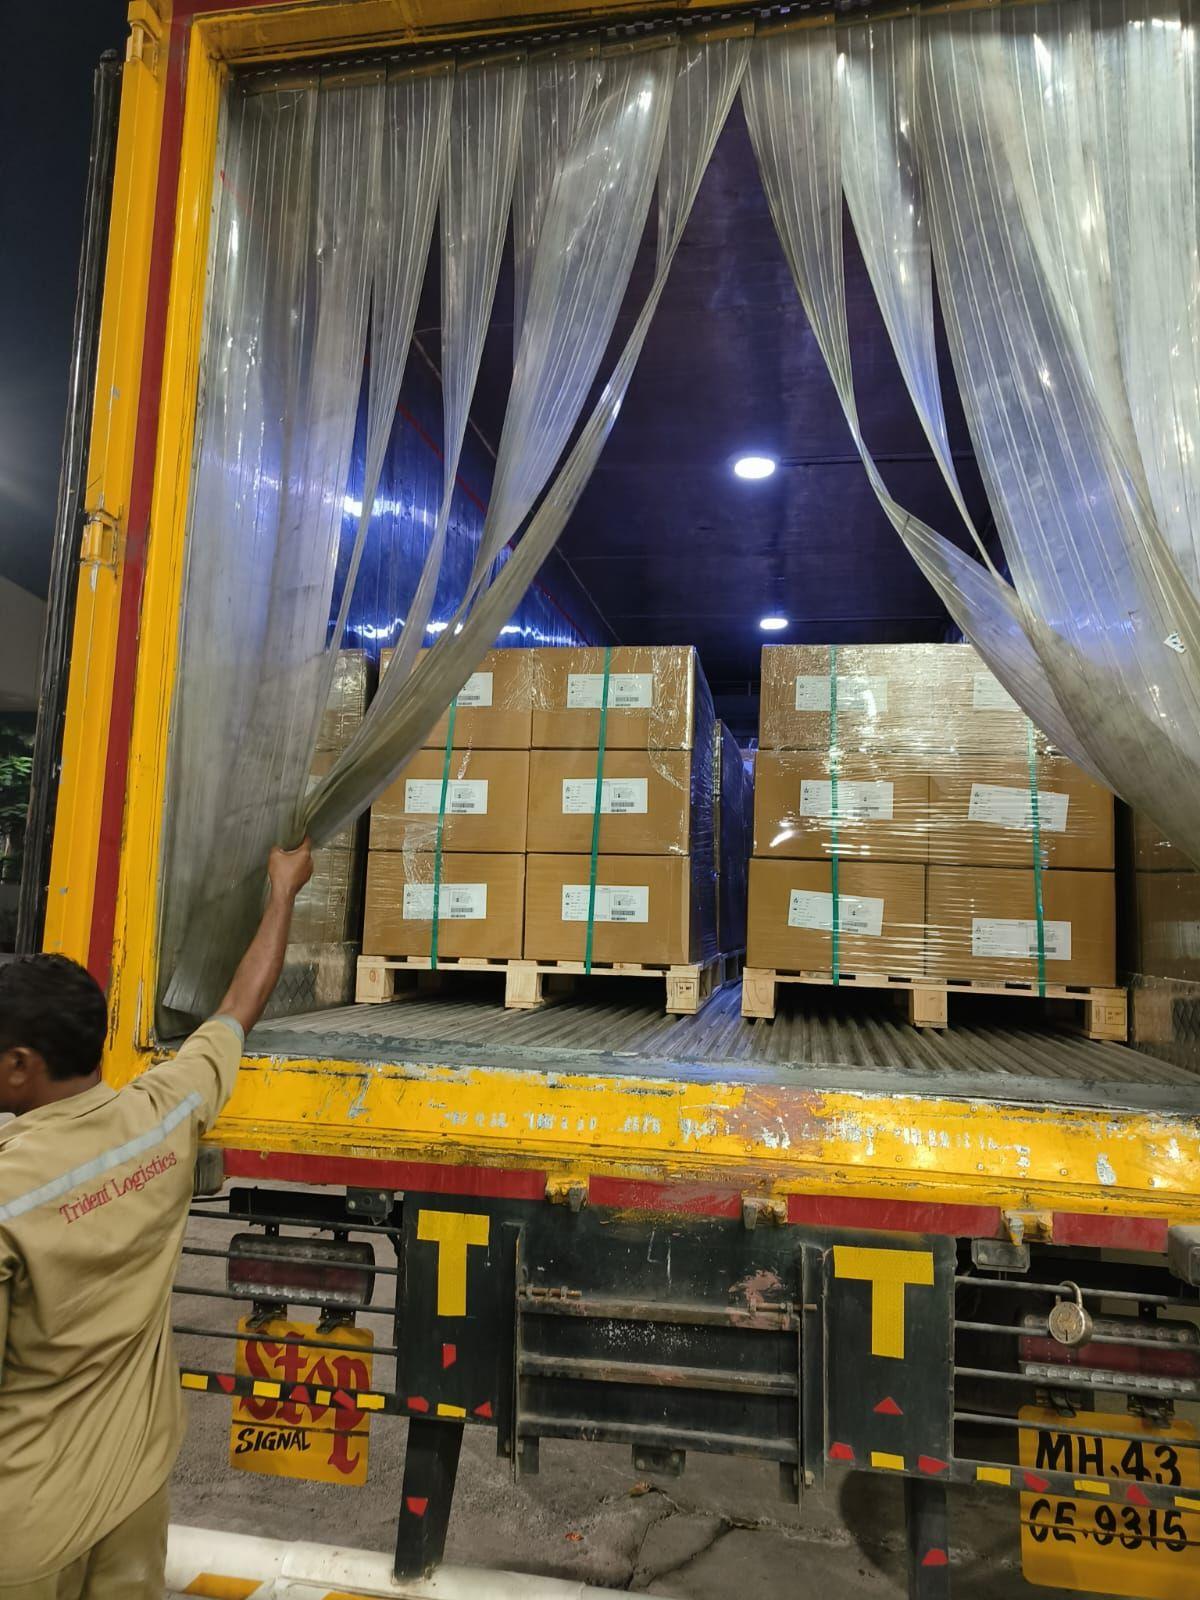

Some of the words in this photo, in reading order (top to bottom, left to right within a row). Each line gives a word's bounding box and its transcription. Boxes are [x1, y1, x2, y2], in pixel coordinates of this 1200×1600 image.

[59, 1193, 113, 1224] Trident
[110, 1152, 178, 1198] Logistics
[235, 1427, 311, 1455] SIGNAL
